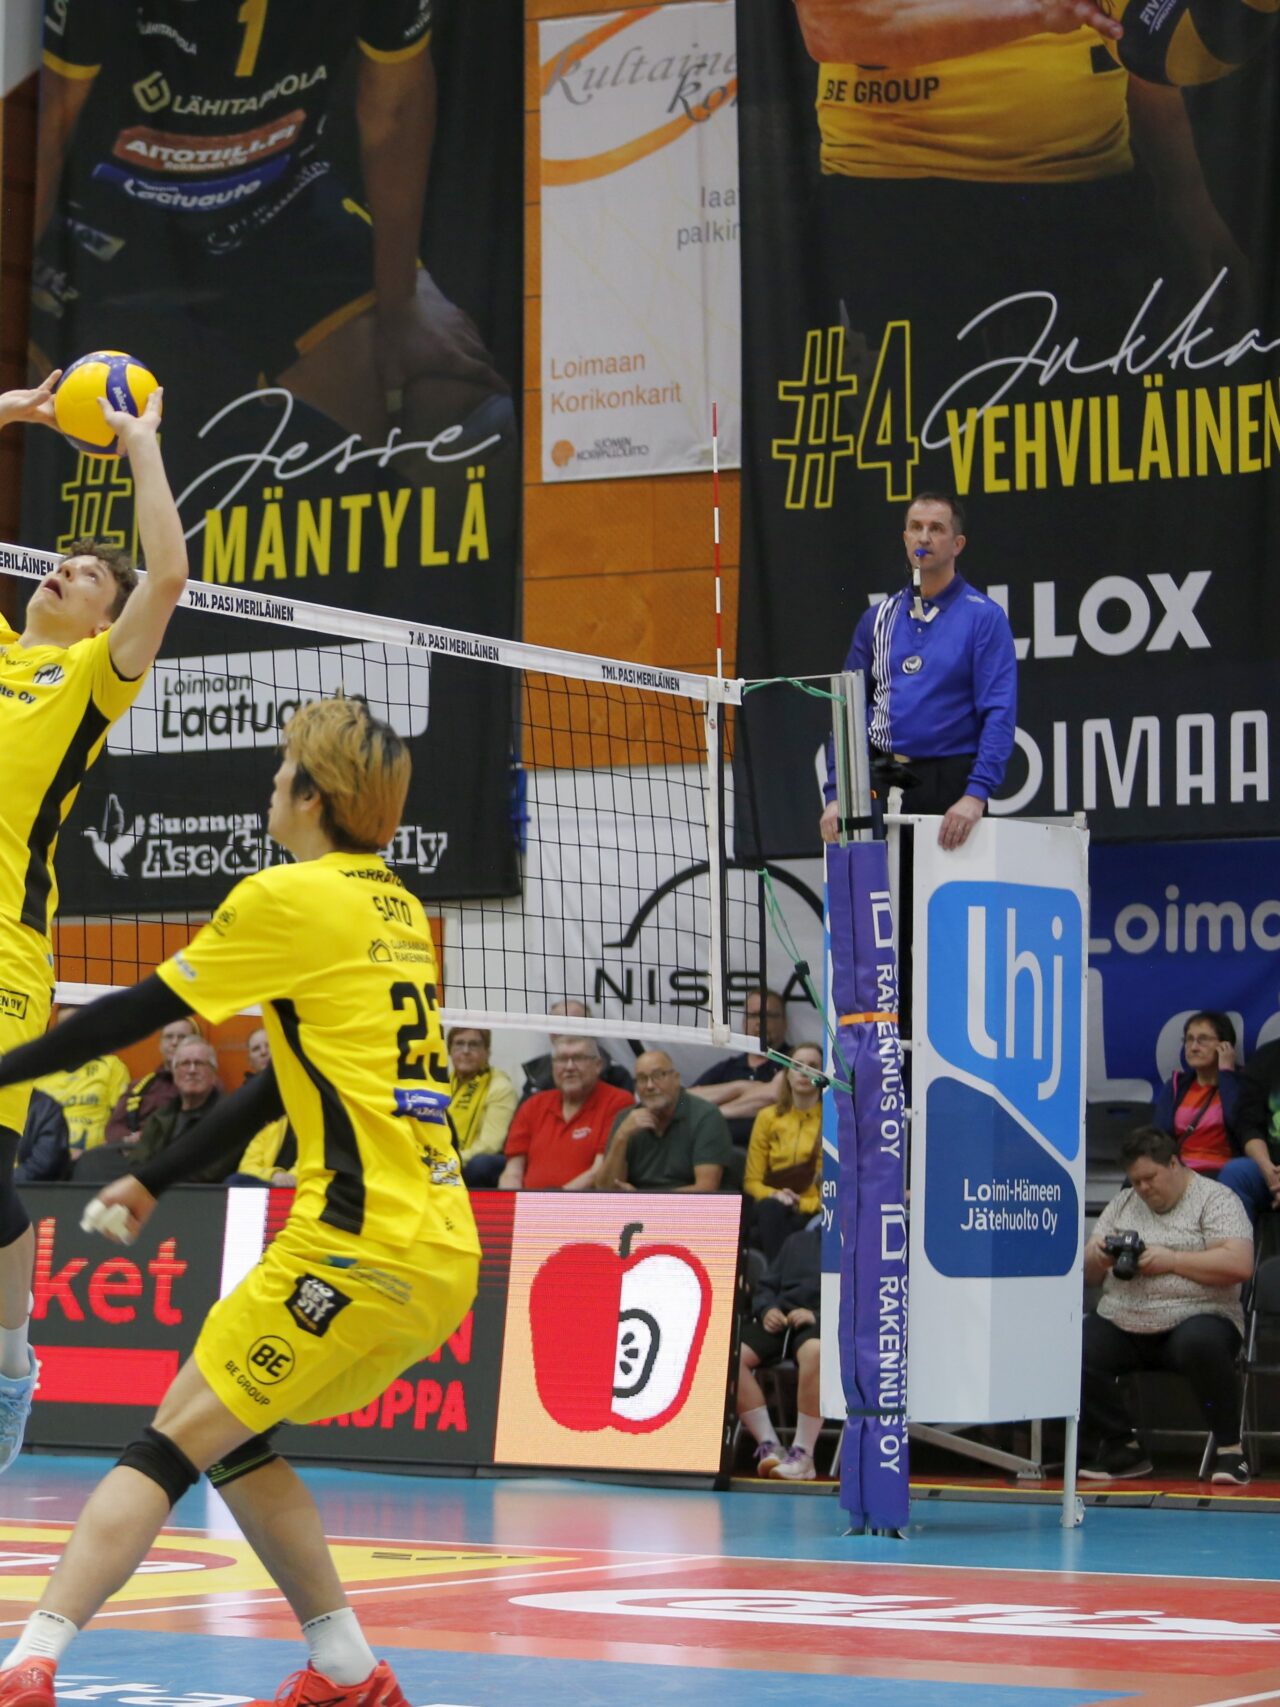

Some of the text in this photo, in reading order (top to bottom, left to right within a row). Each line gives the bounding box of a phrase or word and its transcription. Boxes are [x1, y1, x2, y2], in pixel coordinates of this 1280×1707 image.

[171, 64, 327, 117] LÄHITAPIOLA
[824, 76, 940, 105] BE GROUP
[551, 353, 646, 380] Loimaan
[921, 266, 1280, 450] Jukka
[551, 381, 682, 414] Korikonkarit
[772, 319, 919, 509] #4
[946, 372, 1280, 496] VEHVILÄINEN
[176, 387, 501, 541] Jesse
[202, 465, 490, 584] MÄNTYLÄ
[189, 589, 295, 623] TMI. PASI MERILÄINEN
[428, 634, 448, 651] PASI
[449, 637, 499, 661] MERILÄINEN
[164, 673, 252, 697] Loimaan
[601, 665, 680, 691] TMI. PASI MERILÄINEN
[987, 709, 1270, 816] OIMAA
[148, 812, 263, 835] Suomen
[879, 1119, 902, 1160] OY
[963, 1177, 1061, 1202] Loimi-Hämeen
[961, 1206, 1058, 1235] Jätehuolto Oy
[251, 1343, 291, 1377] BE
[878, 1275, 901, 1475] RAKENNUS OY
[237, 1373, 271, 1408] GROUP
